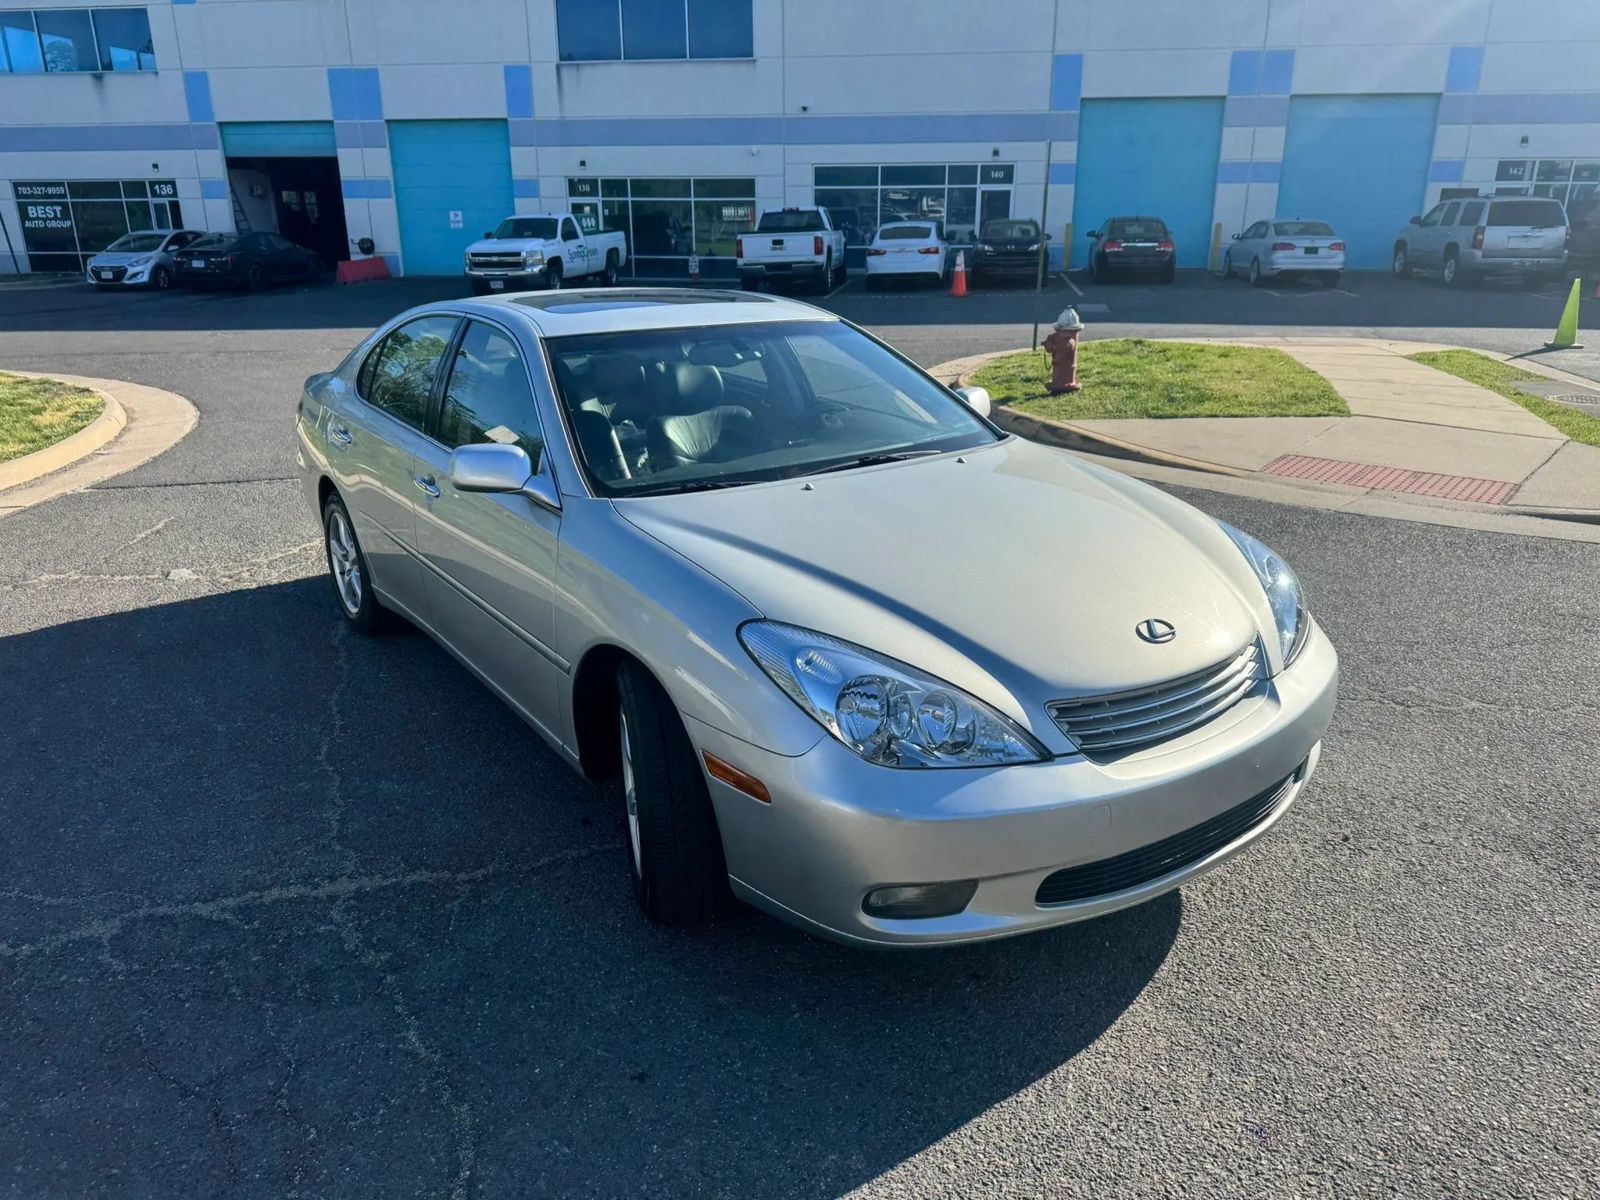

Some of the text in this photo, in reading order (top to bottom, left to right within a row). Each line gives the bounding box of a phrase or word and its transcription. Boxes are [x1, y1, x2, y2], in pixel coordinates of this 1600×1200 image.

[991, 170, 1004, 179] 140
[154, 184, 173, 194] 136
[27, 206, 62, 218] BEST
[25, 220, 71, 228] AUTO GROUP
